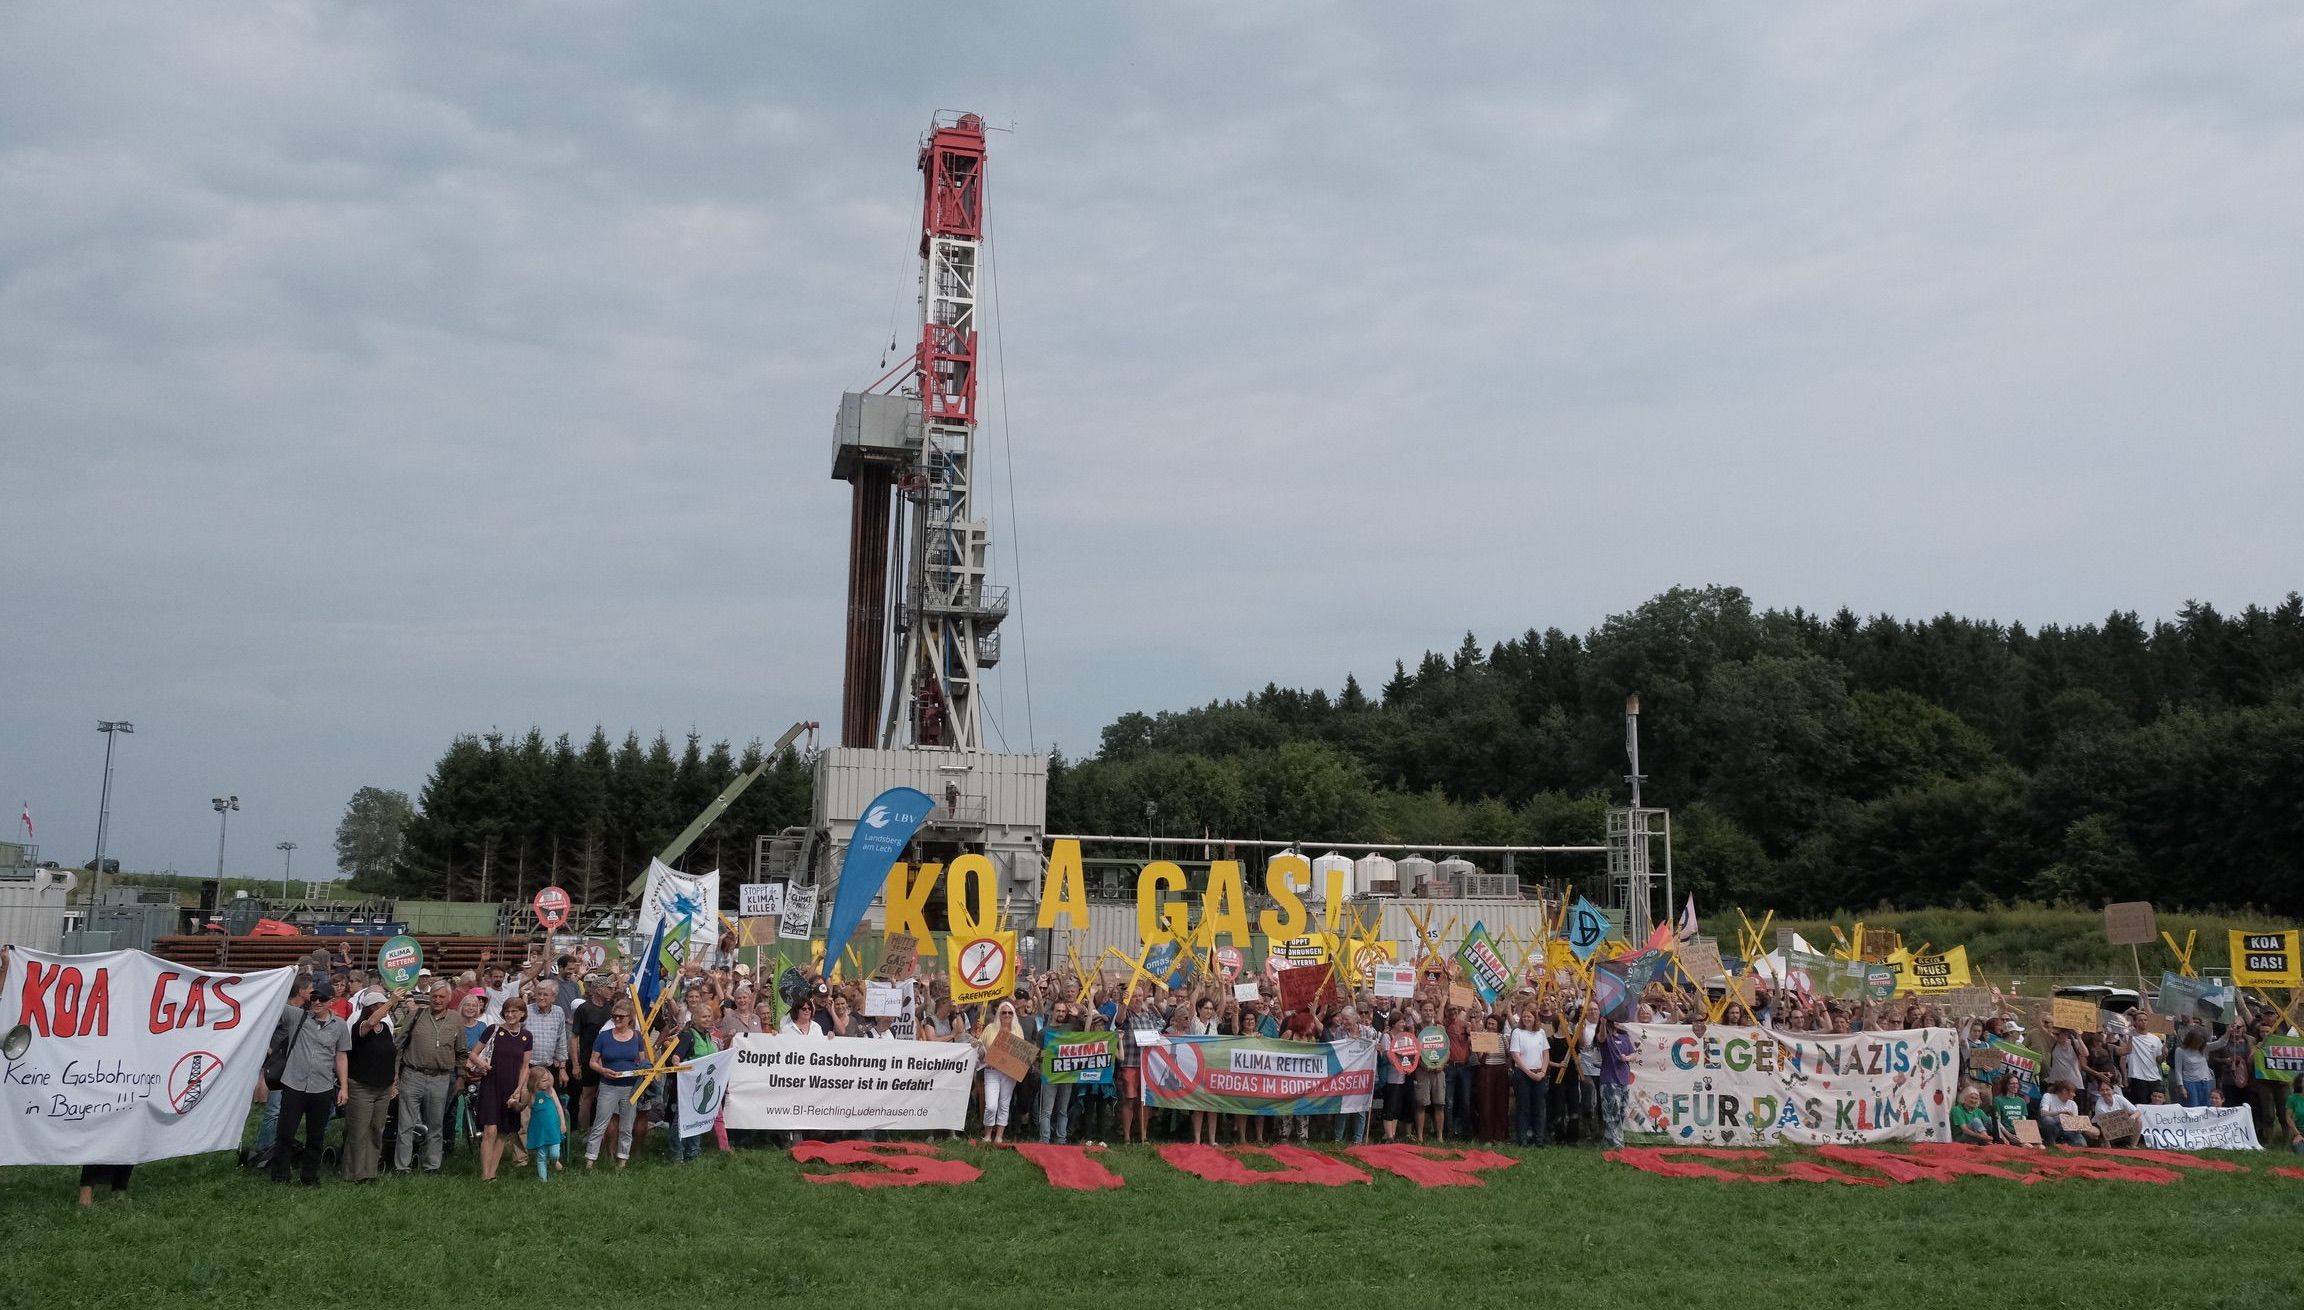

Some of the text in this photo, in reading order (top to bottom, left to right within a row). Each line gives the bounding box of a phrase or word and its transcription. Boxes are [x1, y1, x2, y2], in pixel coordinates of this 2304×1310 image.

[894, 812, 918, 824] LBV
[864, 833, 902, 847] Landsberg
[875, 844, 894, 853] Lech
[744, 886, 768, 895] STOPPT
[747, 895, 780, 903] KLIMA-
[747, 904, 776, 913] KILLER
[2250, 936, 2279, 949] KOA
[389, 948, 411, 958] KLIMA
[1473, 940, 1508, 981] KLIMA
[1463, 945, 1505, 993] RETTEN!
[1917, 964, 1947, 976] NEUES
[2249, 956, 2283, 970] GAS!
[1922, 978, 1947, 986] GAS!
[18, 961, 243, 1039] KOA GAS
[1060, 1041, 1106, 1057] KLIMA
[1671, 1036, 1803, 1074] GEGEN
[1815, 1039, 1910, 1076] NAZIS
[737, 1050, 969, 1074] Stoppt die Gasbohrung in Reichling!
[1053, 1054, 1111, 1072] RETTEN!
[1234, 1052, 1323, 1074] KLIMA RETTEN!
[2000, 1050, 2034, 1070] KLIM
[2266, 1056, 2304, 1071] RETT
[4, 1059, 161, 1098] Keine Gasbohrungen
[769, 1074, 934, 1091] Unser Wasser ist in Gefahr!
[1210, 1073, 1258, 1092] ERDGAS
[1263, 1077, 1276, 1094] IM
[26, 1101, 40, 1115] in
[766, 1105, 929, 1118] www.BI-ReichlingLudenhausen.de
[1751, 1094, 1824, 1130] DAS
[1835, 1094, 1931, 1131] KLIMA
[2155, 1106, 2239, 1126] Deutschland kann
